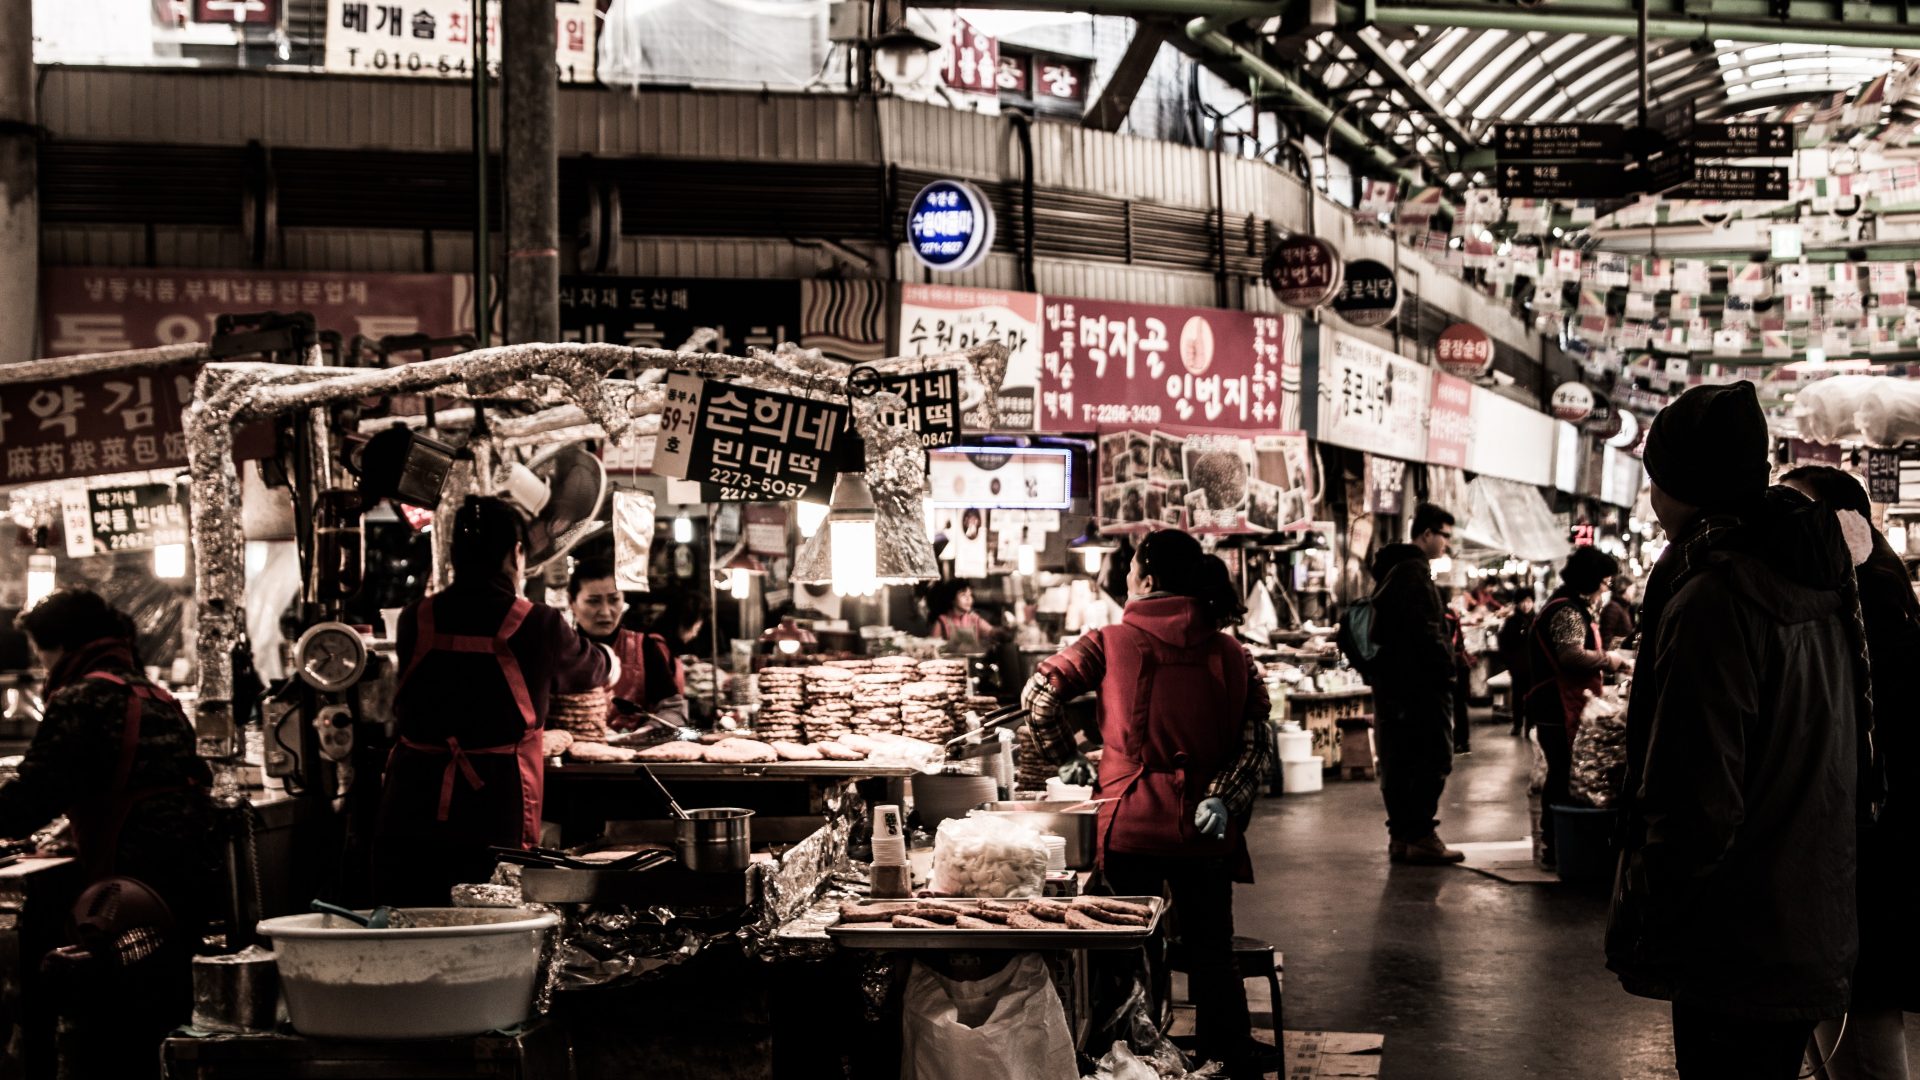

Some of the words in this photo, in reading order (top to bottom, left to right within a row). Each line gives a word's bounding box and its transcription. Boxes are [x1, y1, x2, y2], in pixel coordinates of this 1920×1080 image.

[911, 210, 974, 238] 수원아줌마
[1079, 314, 1170, 380] 먹자골
[1165, 372, 1249, 423] 일번지
[660, 406, 697, 435] 59-1
[705, 390, 838, 452] 순희네
[664, 436, 681, 454] 호
[711, 437, 823, 483] 빈대떡
[709, 467, 808, 499] 2273-5057
